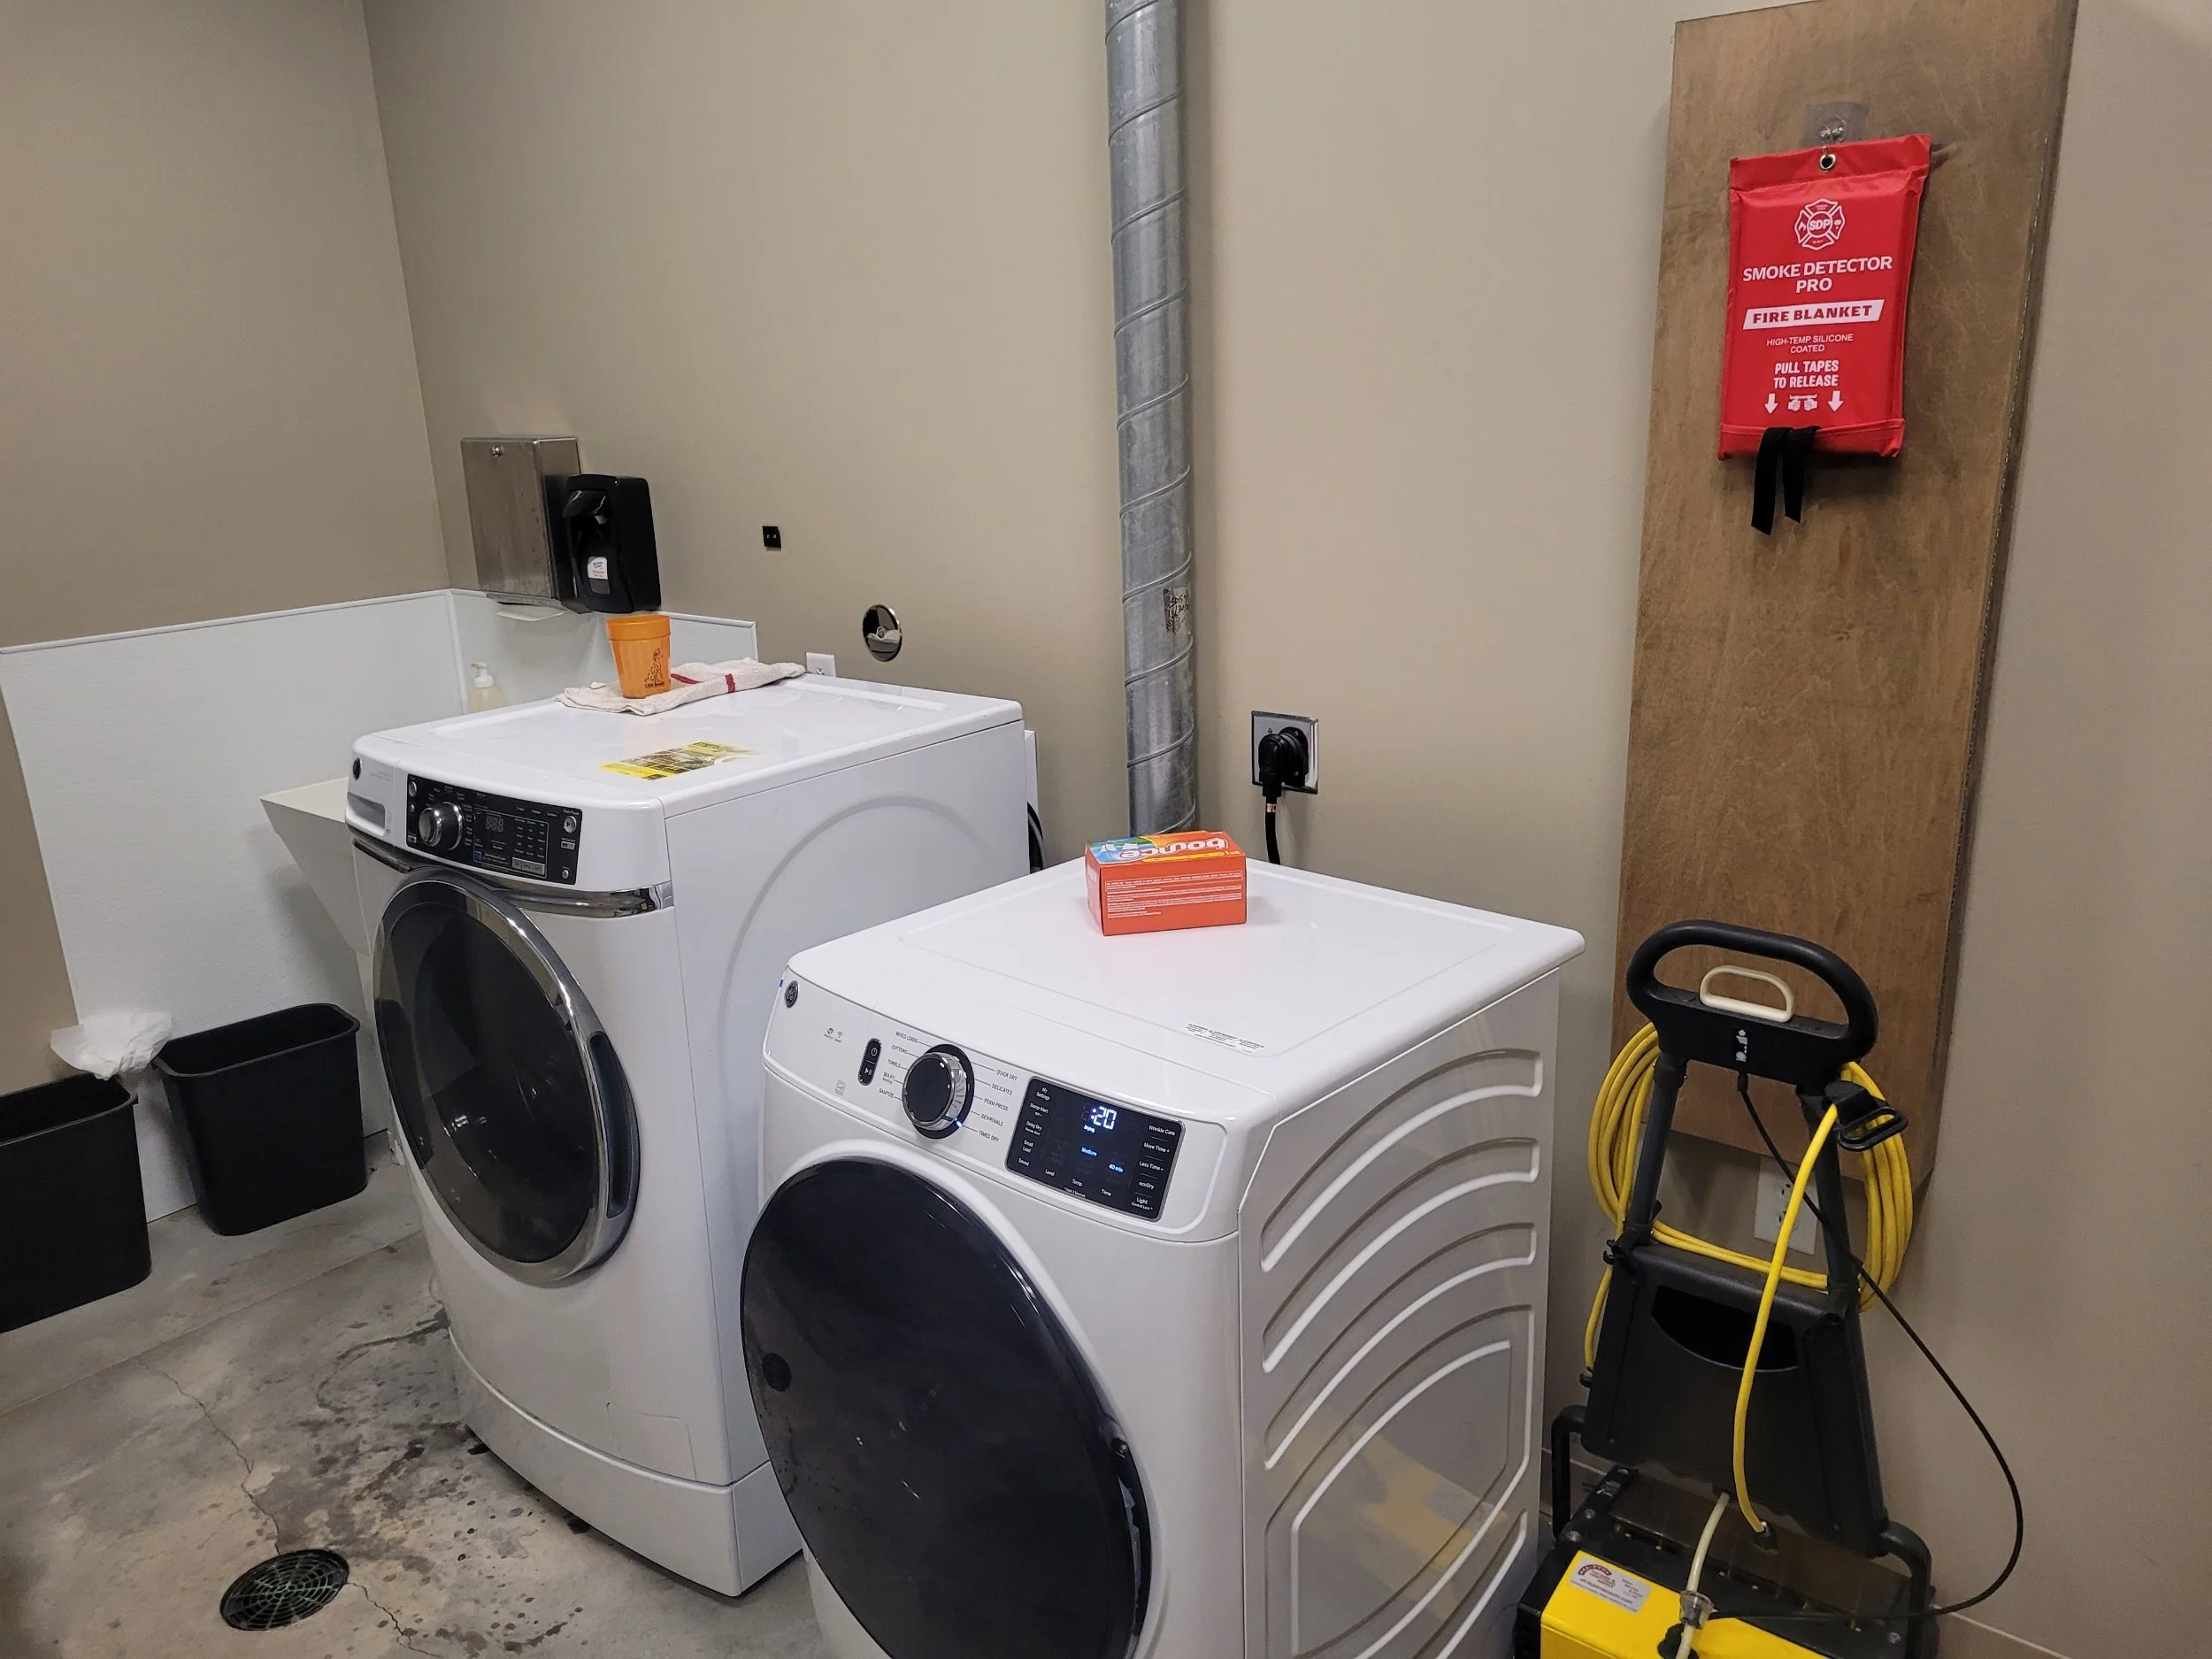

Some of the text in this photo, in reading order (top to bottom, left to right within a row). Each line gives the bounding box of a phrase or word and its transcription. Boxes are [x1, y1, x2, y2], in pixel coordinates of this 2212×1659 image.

[1809, 219, 1831, 231] SDP
[1743, 257, 1893, 281] SMOKE DETECTOR
[1795, 277, 1832, 293] PRO
[1752, 305, 1873, 325] FIRE BLANKET
[1766, 333, 1854, 346] HIGH-TEMP SILICONE
[1790, 343, 1825, 354] COATED
[1774, 359, 1839, 374] PULL TAPES
[1773, 373, 1838, 389] TO RELEASE
[1119, 837, 1227, 858] bounce
[995, 1069, 1009, 1079] QUICK
[991, 1083, 1013, 1095] DELICATES
[984, 1097, 1009, 1111] PERM PRESS
[980, 1113, 1004, 1126] DEWRINKLE
[979, 1130, 991, 1140] TIMED
[1148, 1125, 1165, 1133] Wrinkle
[1071, 1178, 1083, 1187] Temp
[1138, 1181, 1155, 1190] ecoDry
[1101, 1188, 1112, 1197] Time
